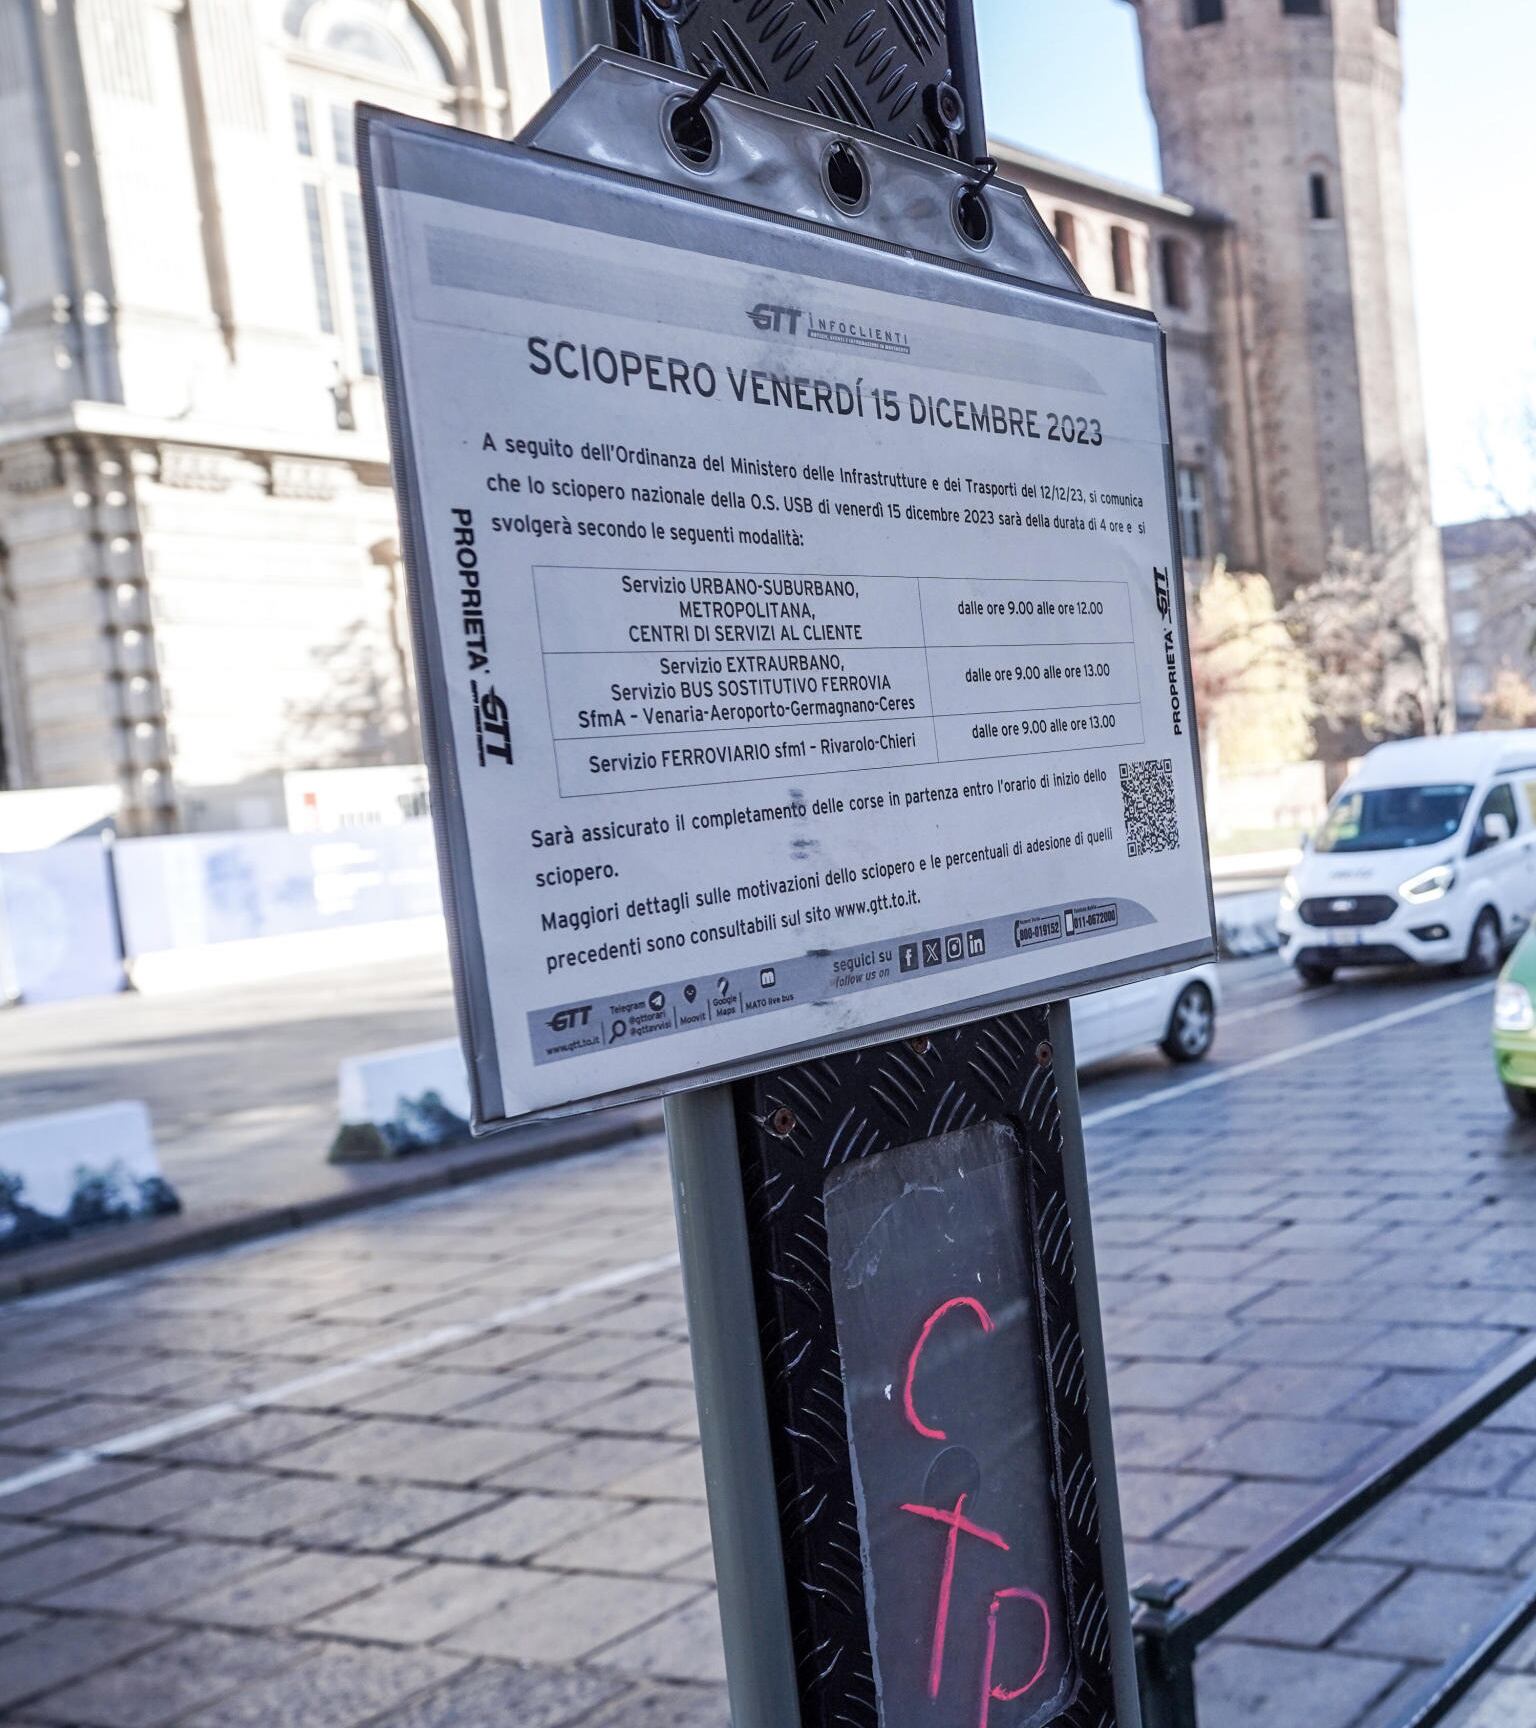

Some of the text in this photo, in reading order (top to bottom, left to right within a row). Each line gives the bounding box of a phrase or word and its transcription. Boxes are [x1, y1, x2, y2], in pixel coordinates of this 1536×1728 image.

[745, 303, 802, 335] GTT
[527, 336, 1103, 447] SCIOPERO VENERDÍ 15 DICEMBRE 2023
[482, 432, 1144, 508] A seguito dell'Ordinanza del Ministero delle Infrastrutture e dei Trasporti del 12/12/23, si comunica
[486, 473, 1146, 535] che lo sciopero nazionale della O.S. USB di venerdì 15 dicembre 2023 sarà della durata di 4 ore e si
[491, 514, 805, 547] svolgerà secondo le seguenti modalità:
[621, 575, 859, 599] Servizio URBANO-SUBURBANO,
[679, 600, 816, 621] METROPOLITANA,
[957, 600, 1104, 616] dalle ore 9.00 alle ore 12.00
[628, 624, 863, 643] CENTRI DI SERVIZI AL CLIENTE
[659, 654, 845, 675] Servizio EXTRAURBANO,
[965, 663, 1111, 683] dalle ore 9.00 alle ore 13.00
[610, 674, 892, 702] Servizio BUS SOSTITUTIVO FERROVIA
[578, 695, 916, 729] SfmA Venaria-Aeroporto-Germagnano-Ceres
[971, 714, 1116, 739] dalle ore 9.00 alle ore 13.00
[589, 731, 917, 774] Servizio FERROVIARIO sfm1 Rivarolo-Chieri
[531, 768, 1108, 849] Sarà assicurato il completamento delle corse in partenza entro l'orario di inizio dello
[535, 864, 619, 888] sciopero.
[540, 826, 1113, 932] Maggiori dettagli sulle motivazioni dello sciopero e le percentuali di adesione di quelli
[546, 889, 921, 975] precedenti sono consultabili sul sito www.gtt.to.it.
[833, 950, 892, 972] seguici su
[834, 967, 890, 989] follow us on
[609, 1001, 646, 1015] Telegram
[712, 994, 737, 1008] Google
[716, 1006, 736, 1018] Maps
[745, 993, 795, 1011] MATO live bus
[546, 1005, 593, 1032] GTT
[680, 1012, 706, 1026] Moovit
